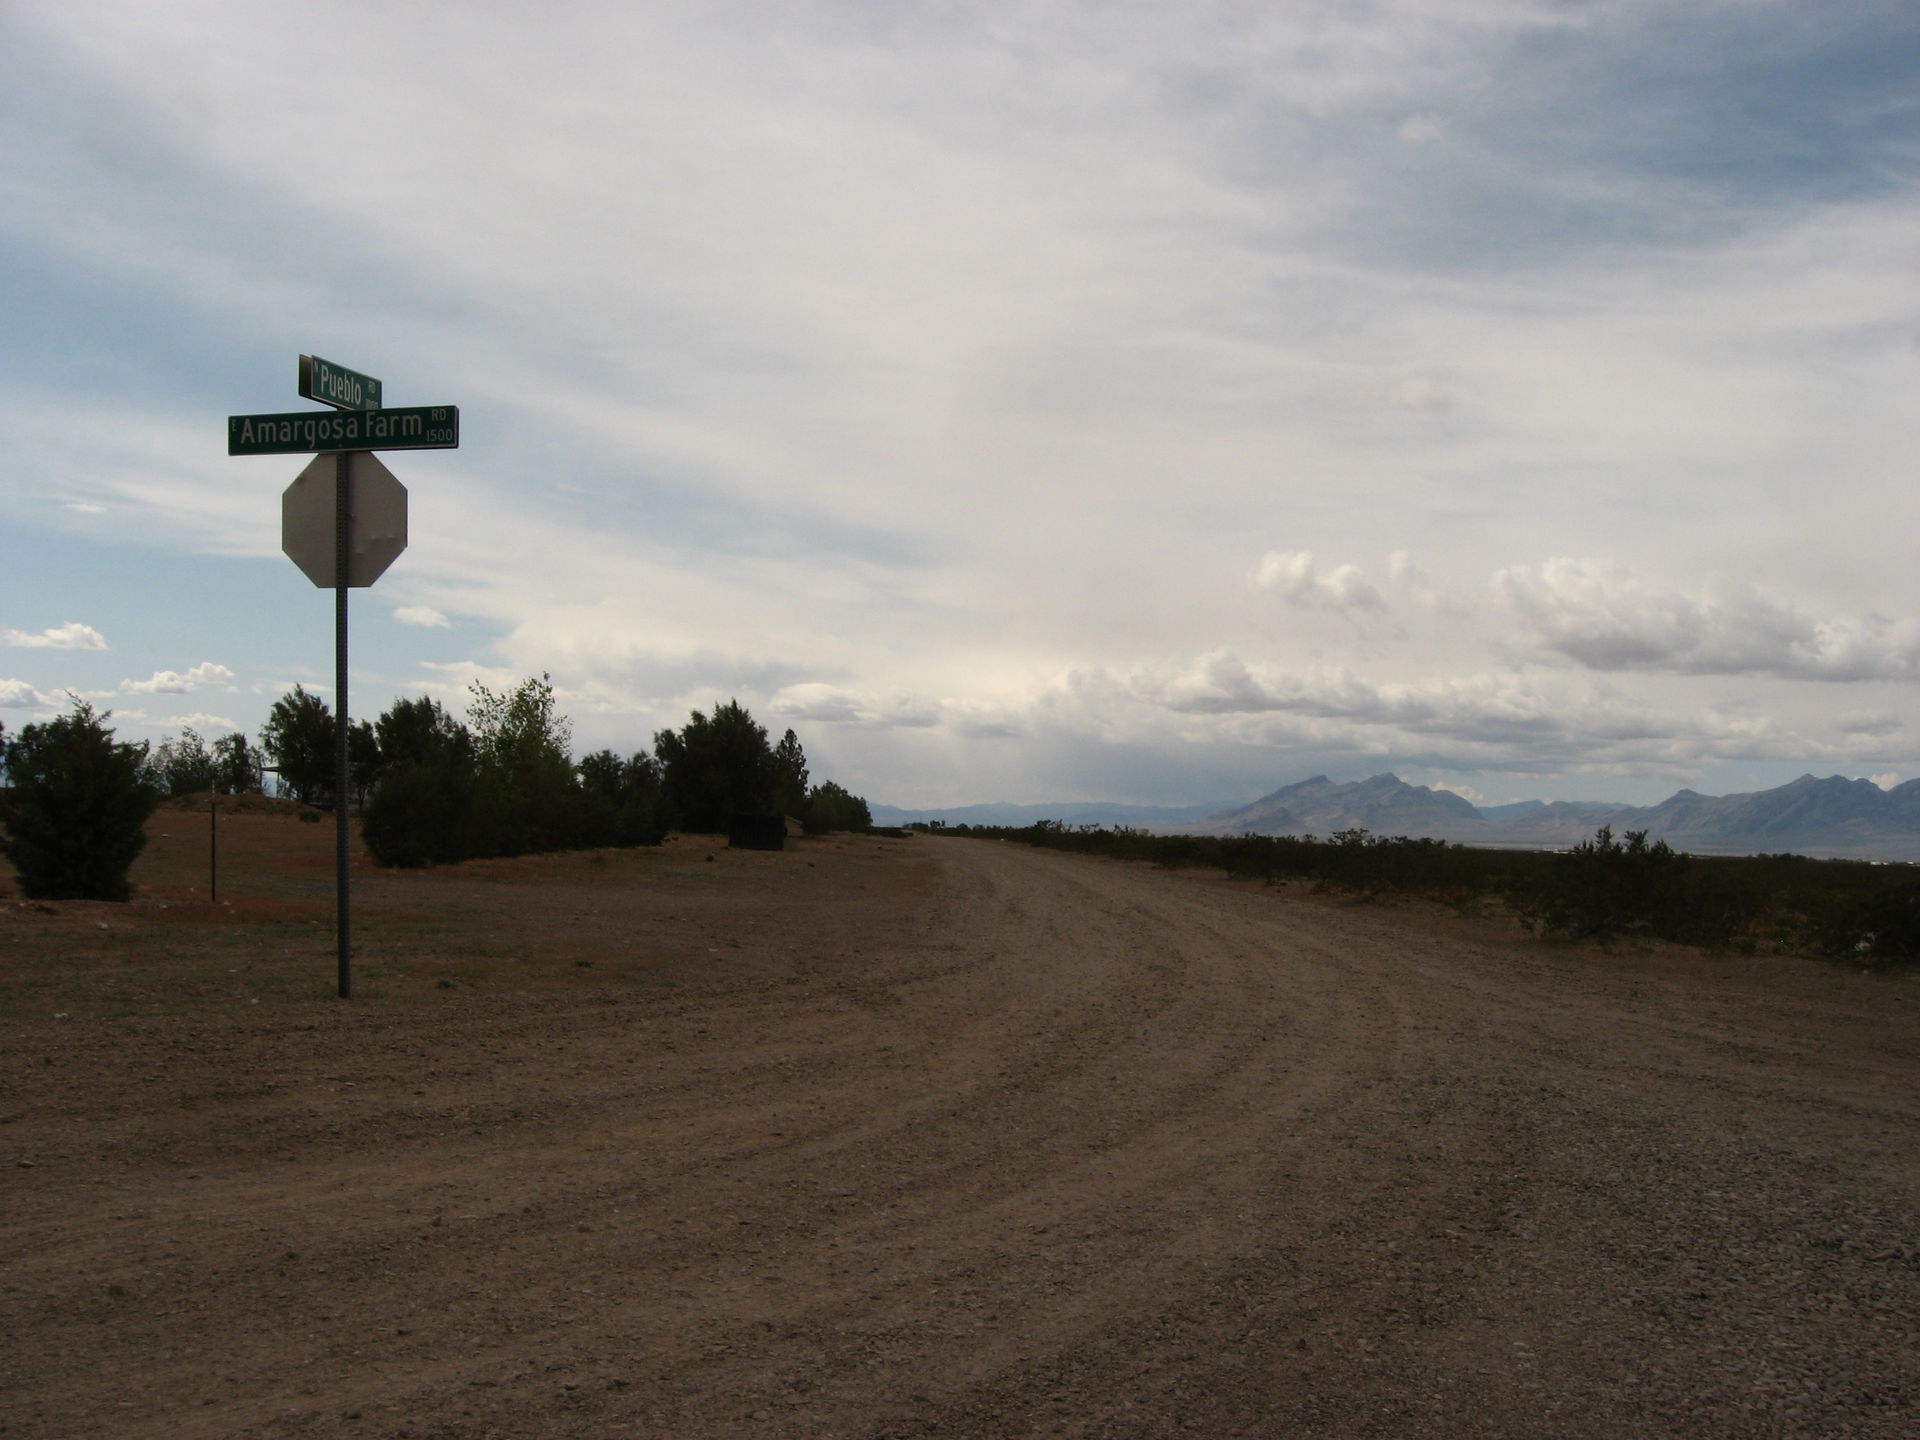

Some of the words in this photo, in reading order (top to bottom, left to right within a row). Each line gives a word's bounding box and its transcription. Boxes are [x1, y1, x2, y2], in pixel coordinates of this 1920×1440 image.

[321, 364, 361, 405] Pueblo
[240, 417, 358, 449] Amargosa
[366, 411, 422, 437] Farm
[431, 408, 447, 422] RD
[426, 428, 453, 442] 1500
